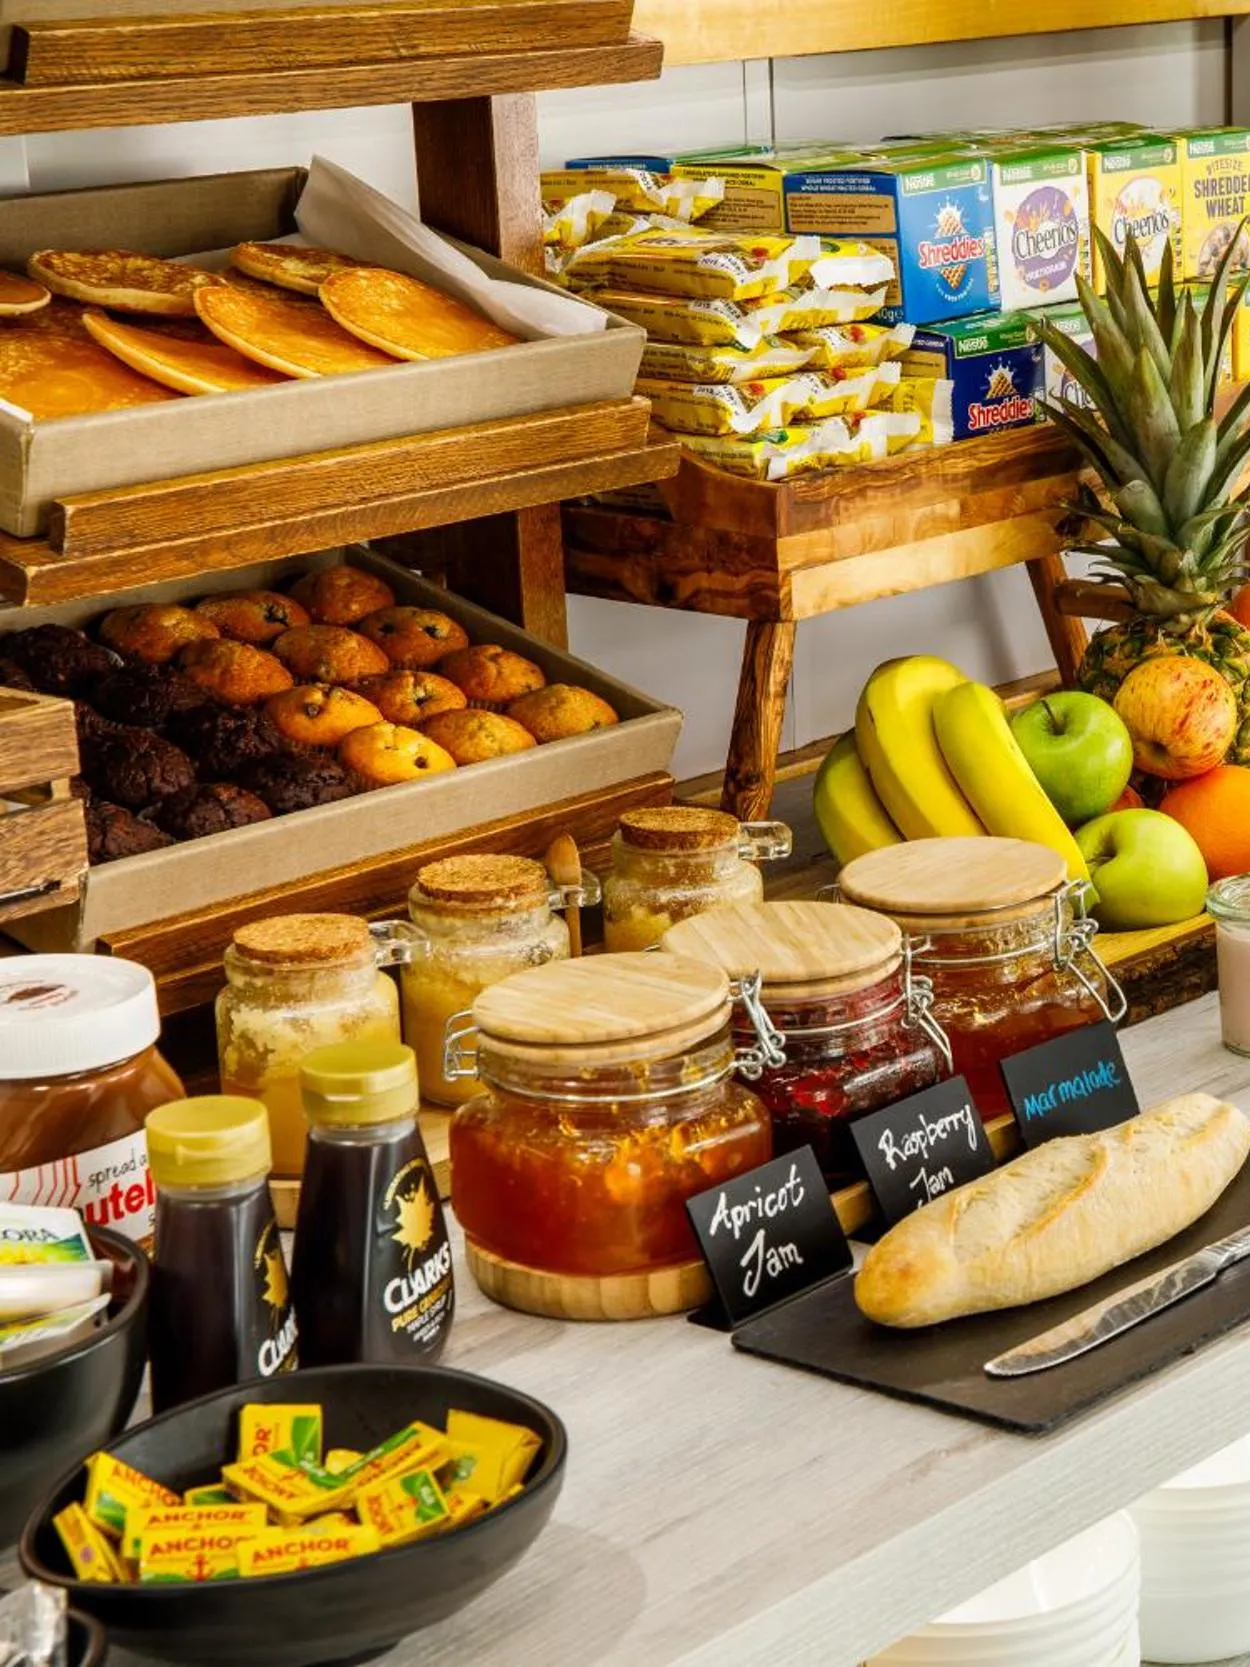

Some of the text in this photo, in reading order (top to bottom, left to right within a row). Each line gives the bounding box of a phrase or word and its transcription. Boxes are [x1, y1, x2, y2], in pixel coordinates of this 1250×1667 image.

[1114, 207, 1170, 244] Cheerios
[1206, 197, 1245, 219] WHEAT
[919, 237, 985, 268] Shreddies
[1014, 221, 1079, 259] Cheerios
[968, 396, 1034, 430] Shreddies
[878, 1104, 978, 1170] Raspberry
[88, 1148, 136, 1193] spread
[909, 1166, 954, 1210] Jam
[84, 1167, 157, 1227] utel
[709, 1163, 805, 1240] Apricot
[740, 1228, 804, 1297] Jam
[149, 1511, 246, 1524] ANCHOR
[252, 1539, 350, 1564] ANCHOR
